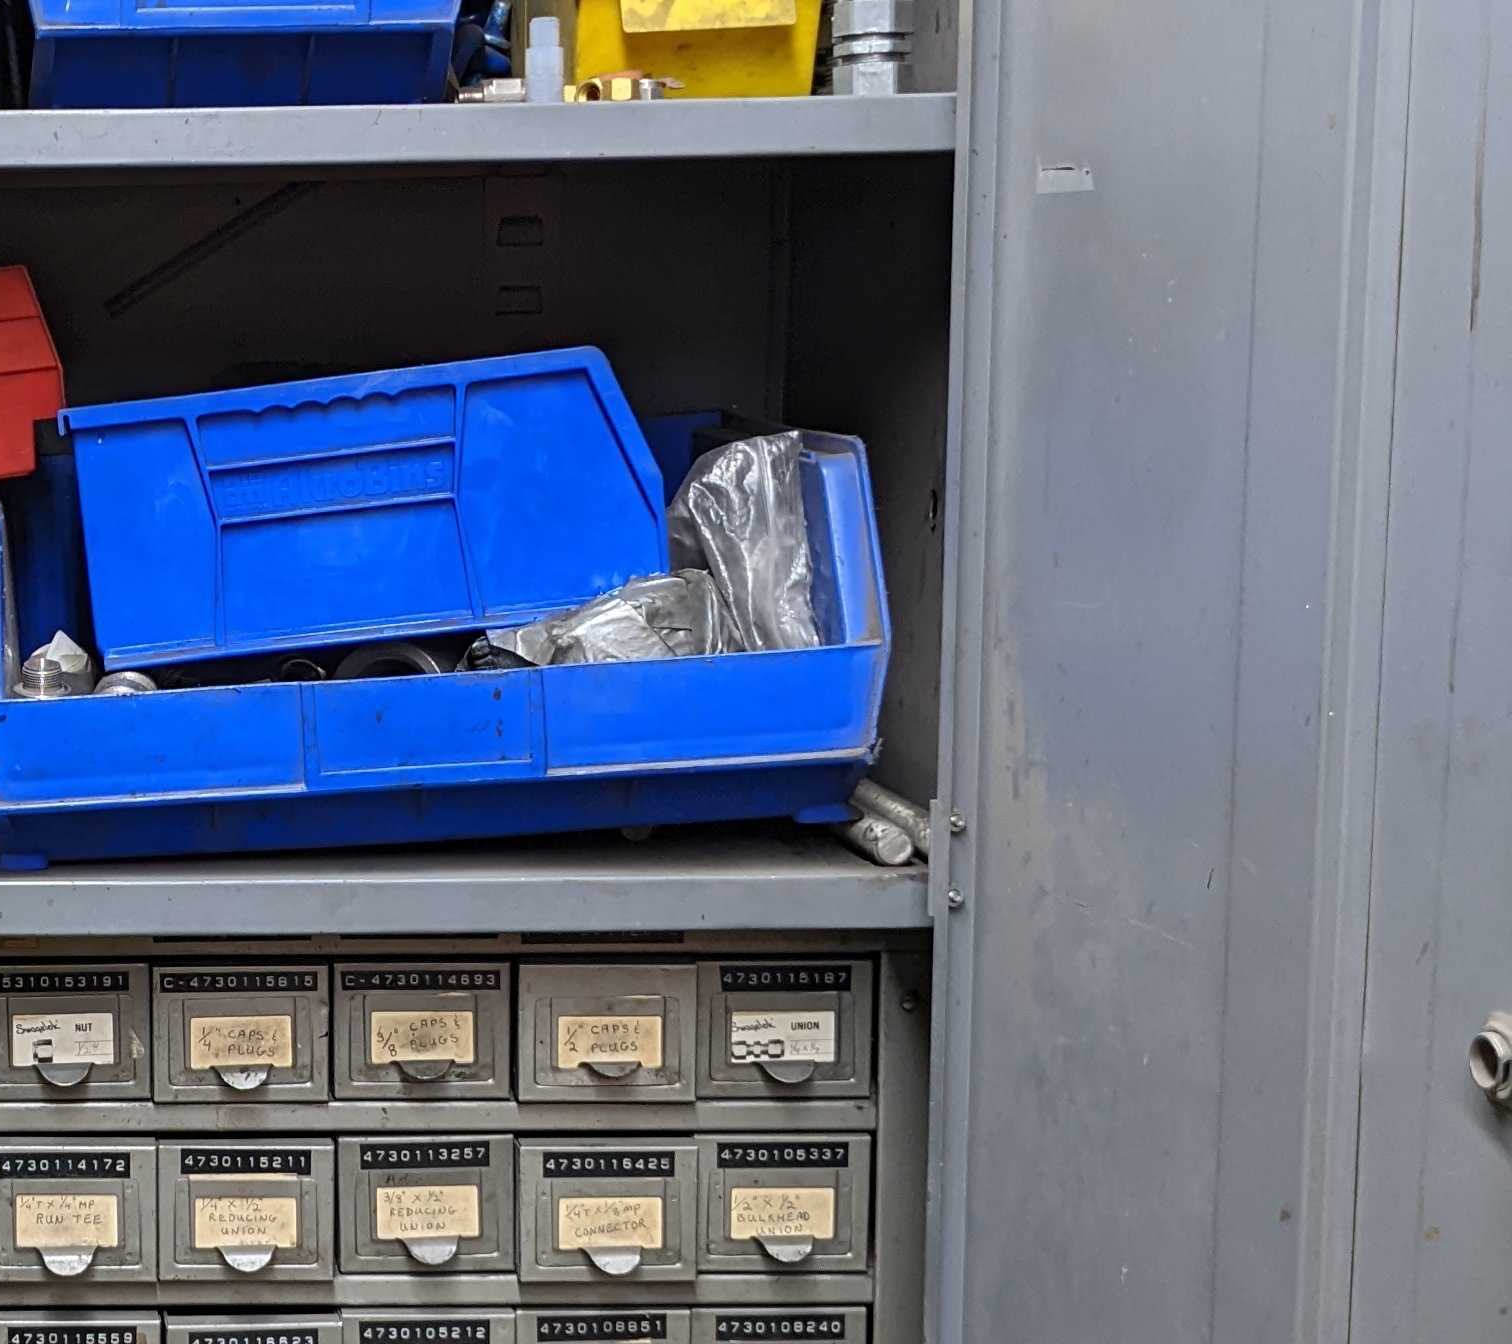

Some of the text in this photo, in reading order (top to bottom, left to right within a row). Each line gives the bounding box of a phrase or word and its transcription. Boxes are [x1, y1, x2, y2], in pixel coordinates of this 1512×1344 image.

[2, 975, 125, 988] 5310153191
[75, 1023, 92, 1032] NUT
[791, 1020, 820, 1031] UNION
[363, 1147, 486, 1162] 4730113257
[720, 1148, 845, 1162] 4730105337
[2, 1158, 127, 1172] 4730114172
[184, 1155, 306, 1169] 4730115211
[545, 1157, 672, 1170] 4730116425
[363, 1327, 486, 1339] 4730105212
[718, 1321, 842, 1334] 4730108240
